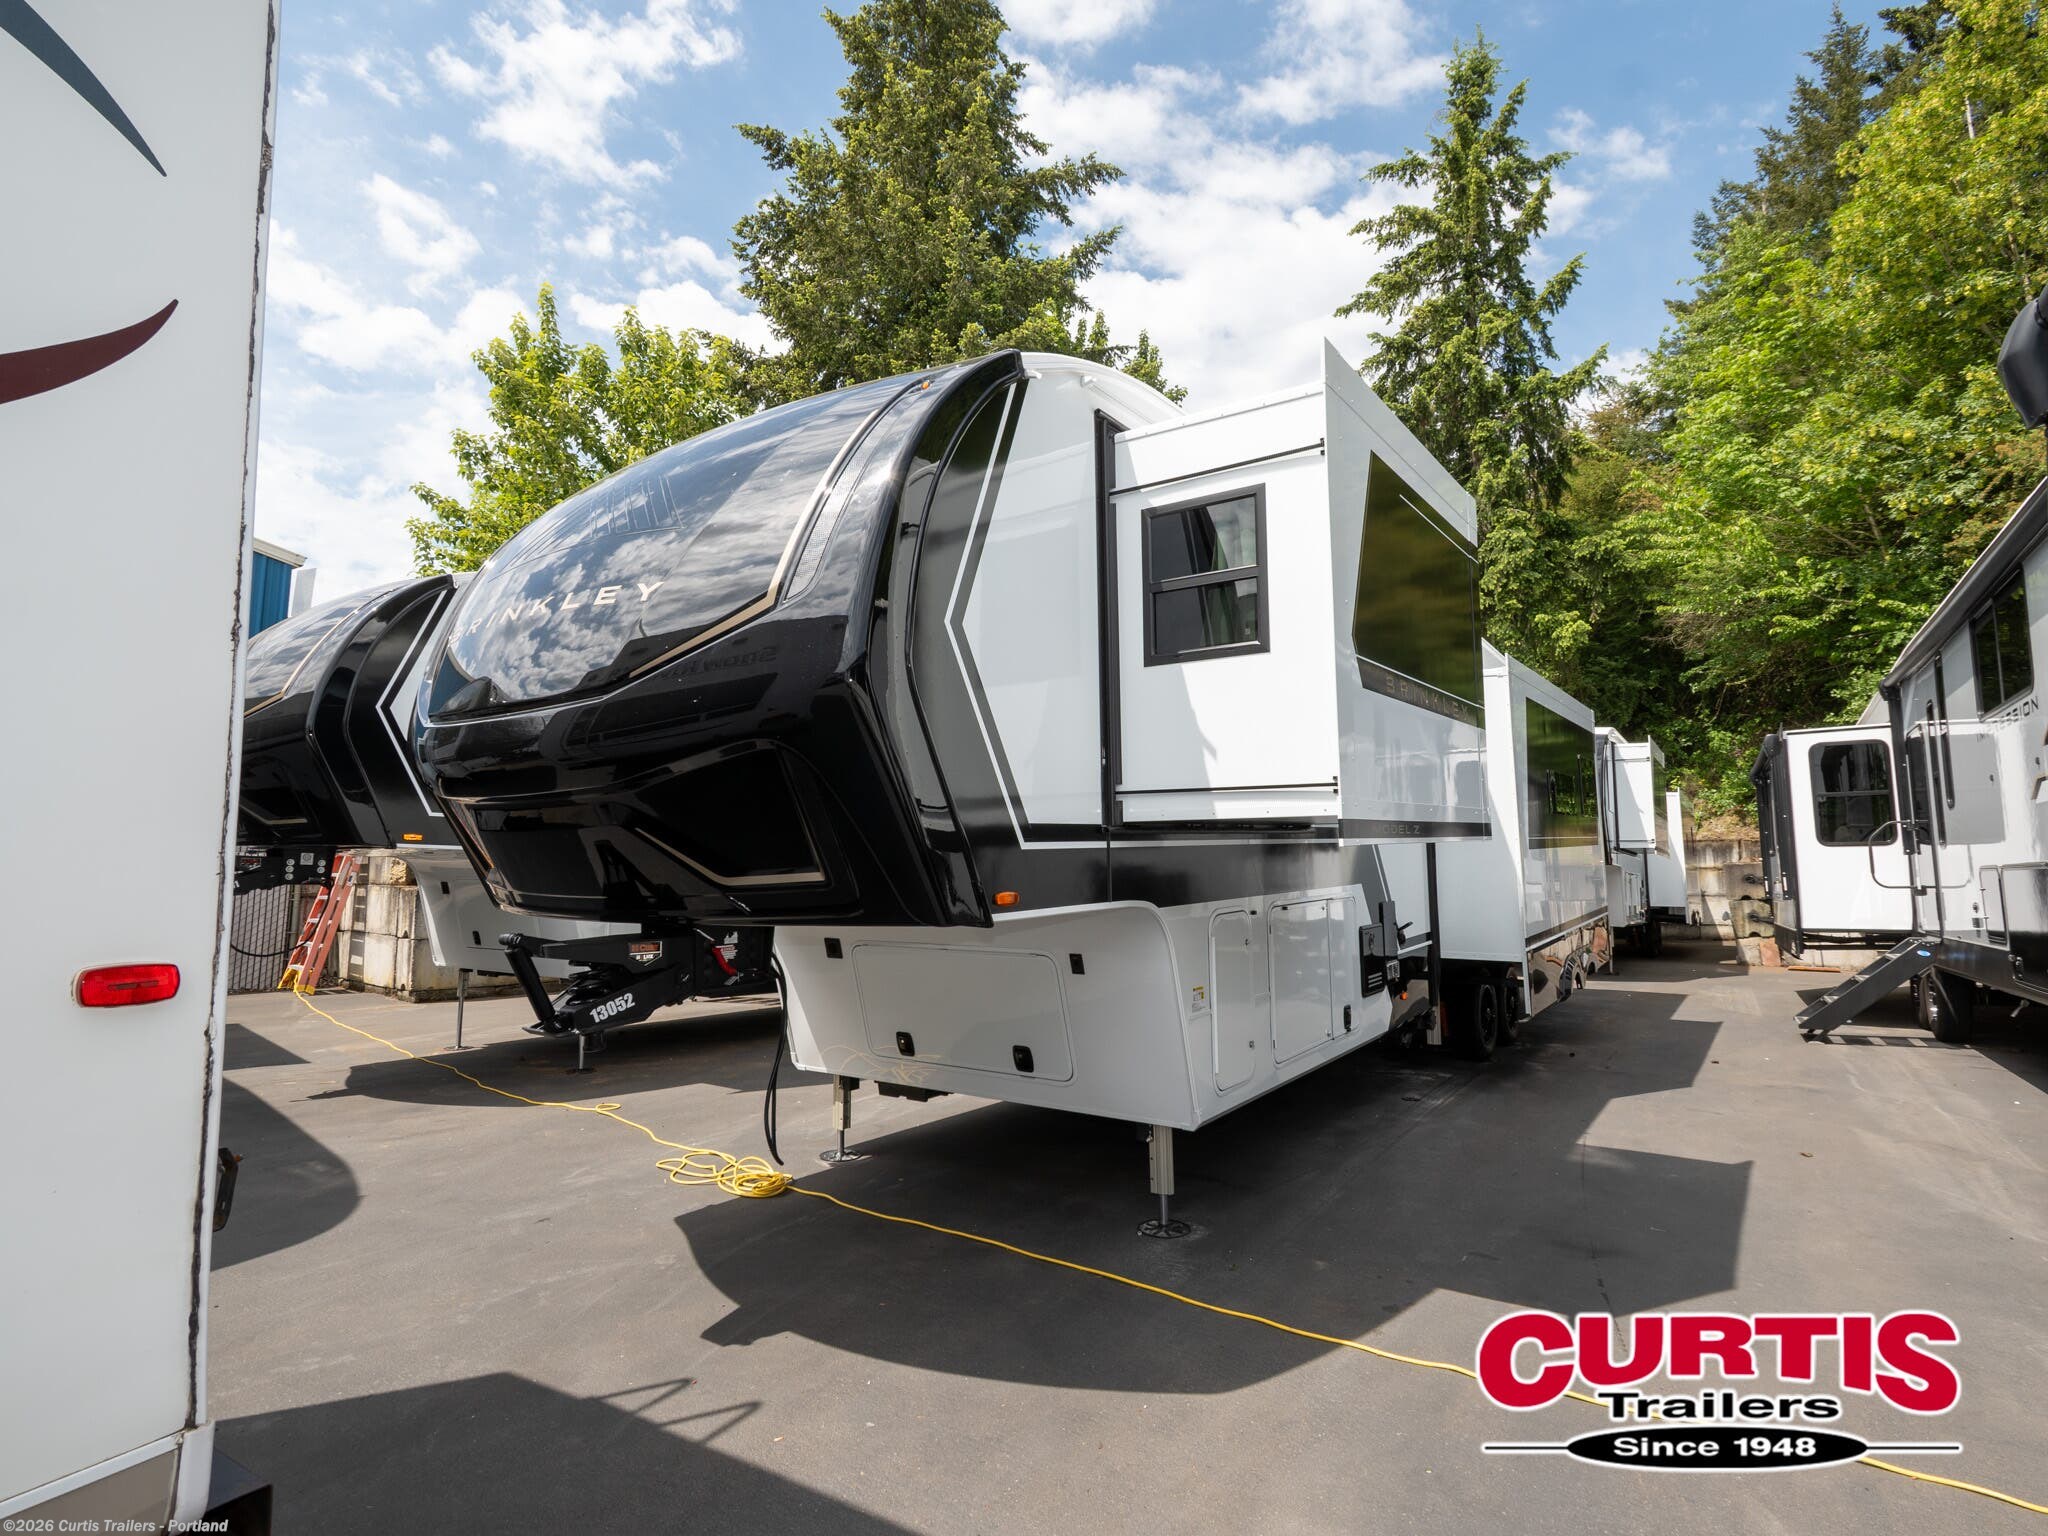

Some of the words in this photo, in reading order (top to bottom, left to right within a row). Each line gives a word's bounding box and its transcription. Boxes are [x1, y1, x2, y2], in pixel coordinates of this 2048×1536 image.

[448, 581, 665, 647] BRINKLEY
[1385, 673, 1469, 721] BRINKLEY
[590, 993, 636, 1023] 13052
